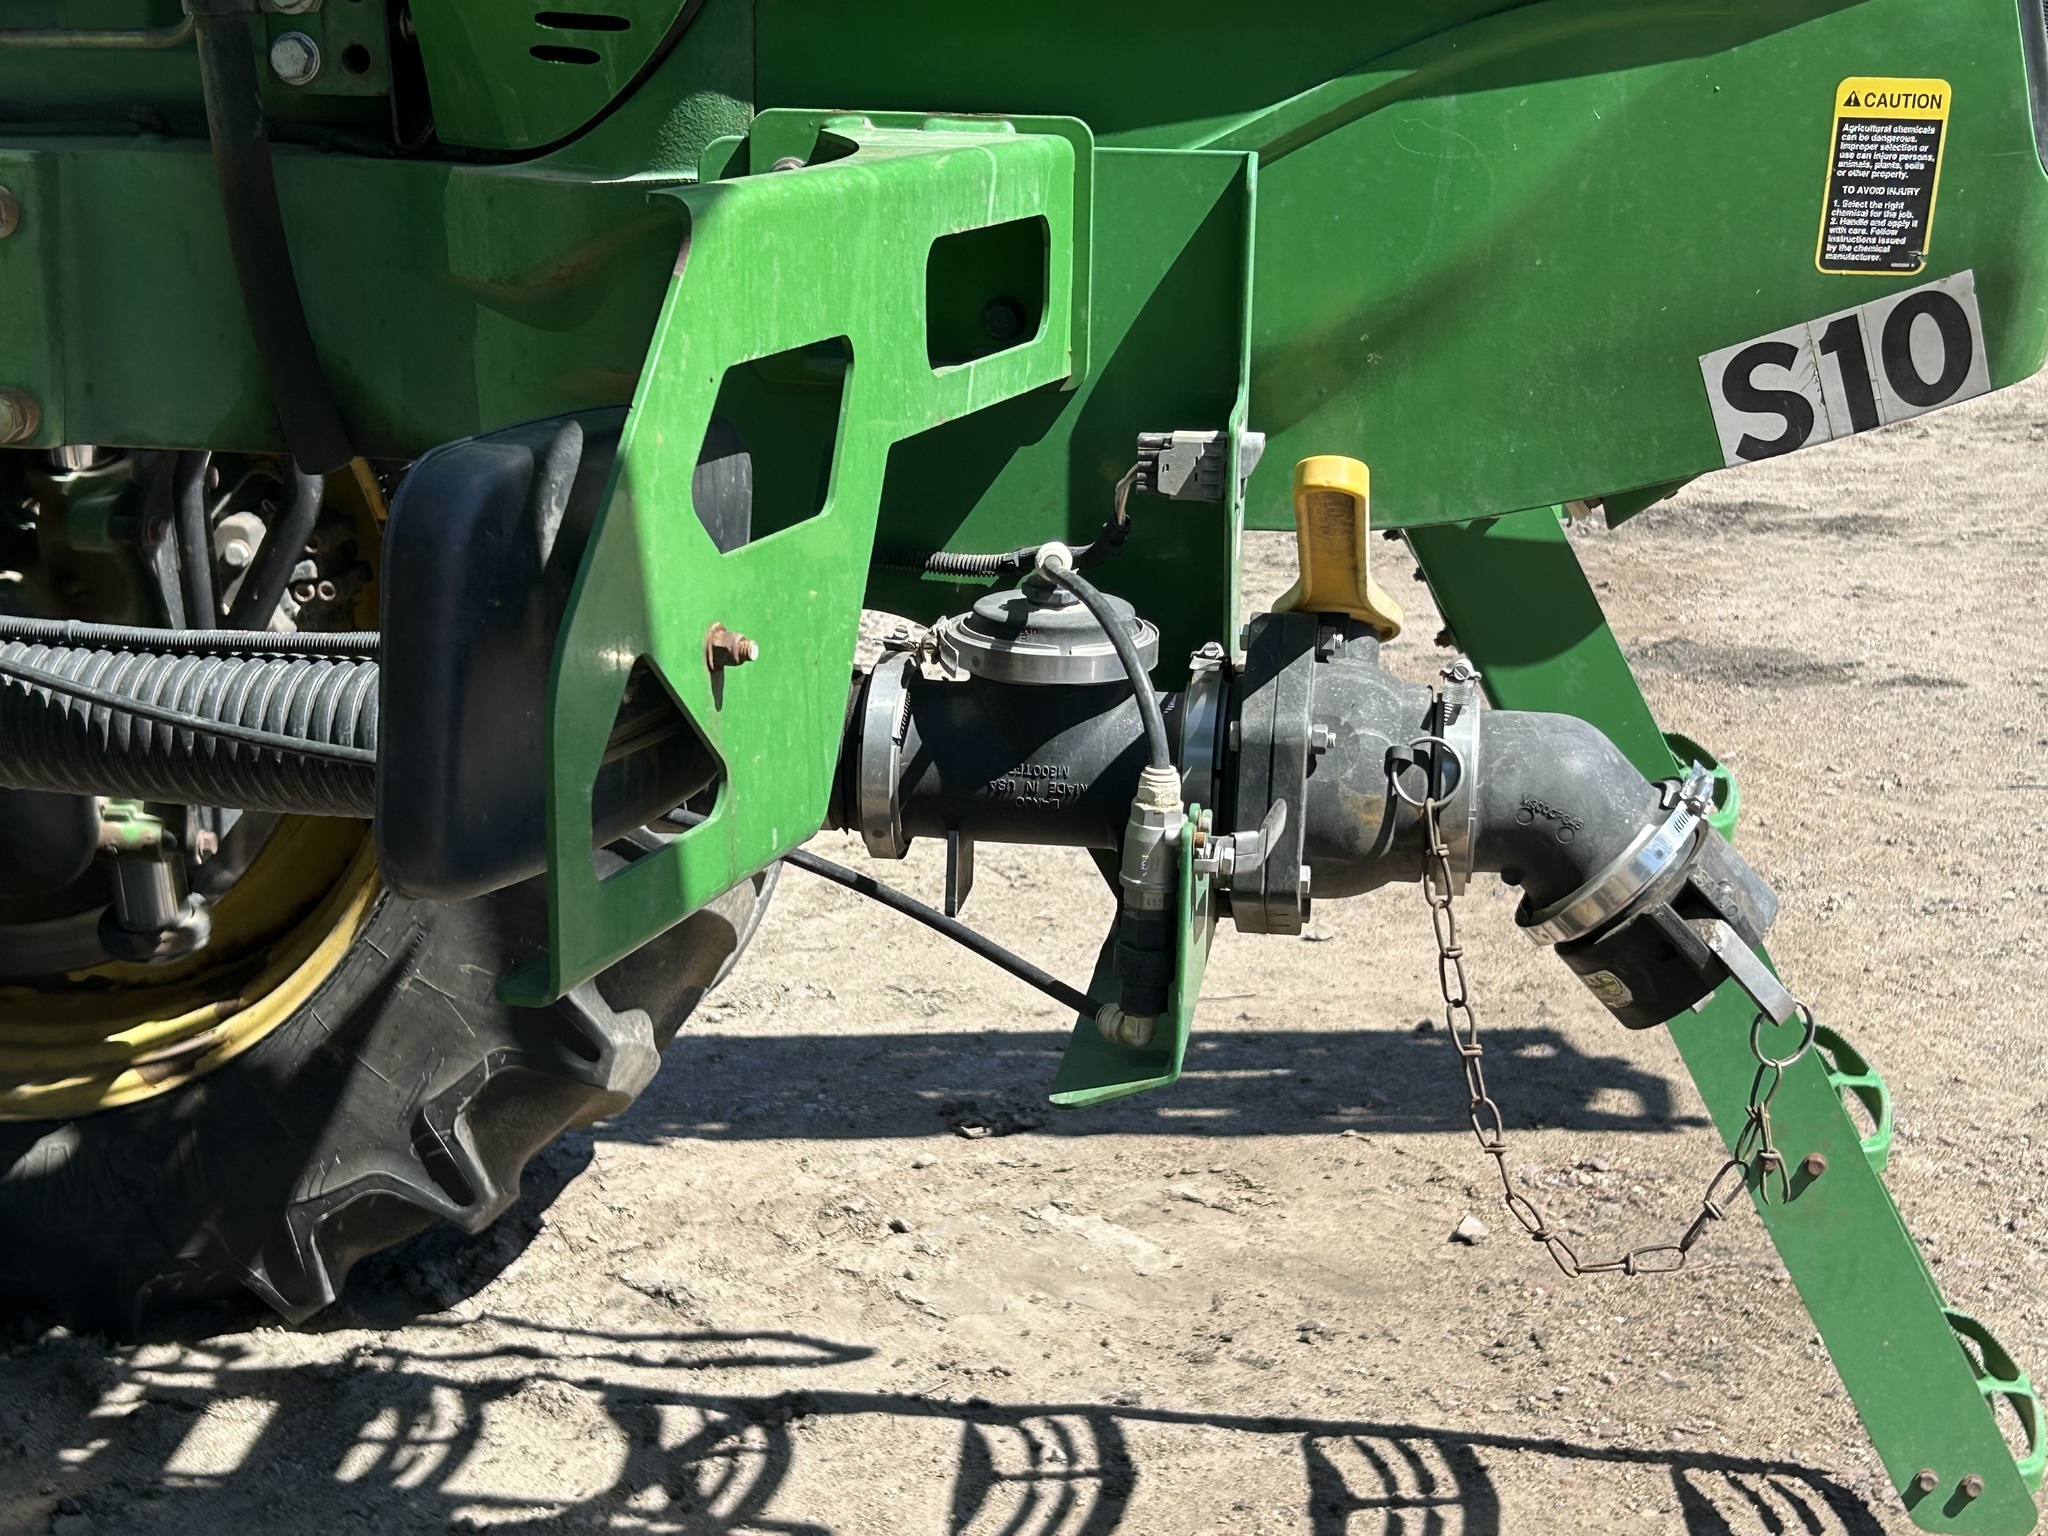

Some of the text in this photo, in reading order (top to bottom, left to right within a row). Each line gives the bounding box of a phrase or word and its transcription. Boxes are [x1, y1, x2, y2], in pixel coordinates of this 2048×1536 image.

[1864, 92, 1942, 109] CAUTION
[1842, 123, 1935, 134] Agricultural chemicals
[1858, 133, 1870, 141] be
[1871, 134, 1917, 143] dangerous.
[1840, 142, 1879, 151] Improper
[1880, 143, 1917, 151] selection
[1873, 152, 1898, 162] injure
[1899, 154, 1935, 162] persons,
[1838, 161, 1925, 170] animals, plants, soils
[1848, 169, 1870, 177] other
[1871, 171, 1909, 180] property.
[1842, 186, 1921, 196] TO AVOID INJURY
[1842, 200, 1868, 208] Select
[1869, 201, 1883, 209] the
[1884, 201, 1904, 210] right
[1869, 210, 1883, 218] for
[1884, 210, 1897, 218] the
[1898, 211, 1914, 220] job.
[1840, 218, 1869, 226] Handle
[1870, 219, 1886, 227] and
[1887, 220, 1910, 229] apply
[1911, 220, 1919, 228] it
[1870, 228, 1899, 236] Follow
[1828, 235, 1907, 245] instructions issued
[1826, 243, 1891, 253] by the chemical
[1825, 253, 1882, 262] manufacturer.
[1722, 290, 1973, 461] S10
[990, 779, 1016, 791] USA
[1026, 780, 1040, 792] IN
